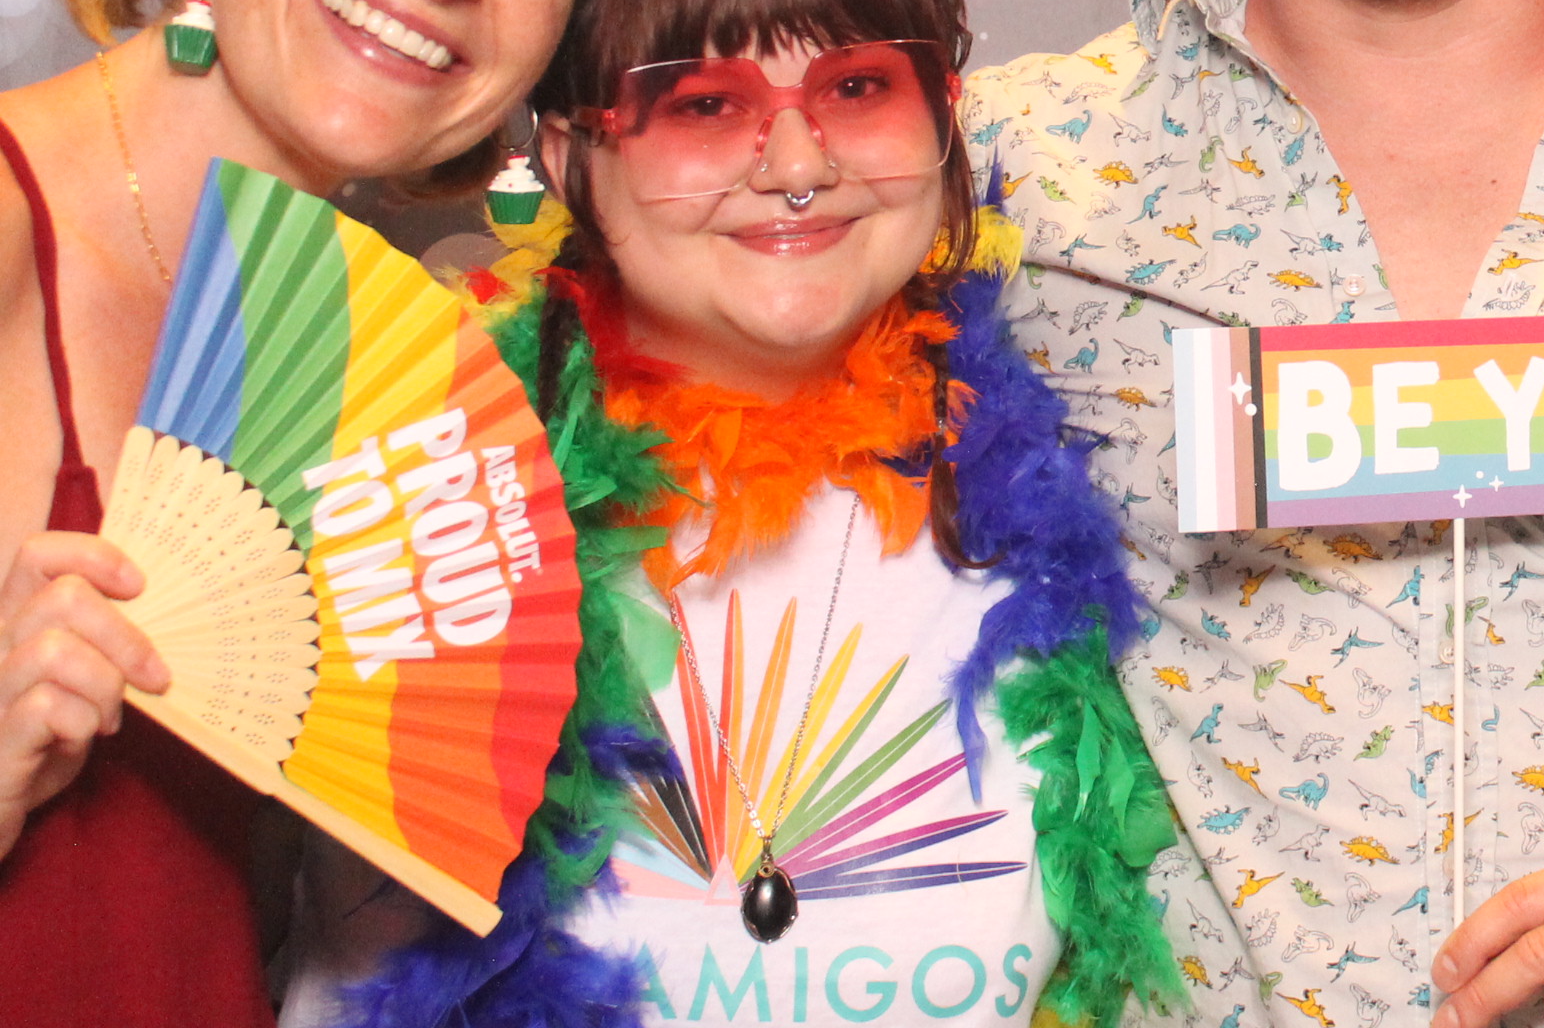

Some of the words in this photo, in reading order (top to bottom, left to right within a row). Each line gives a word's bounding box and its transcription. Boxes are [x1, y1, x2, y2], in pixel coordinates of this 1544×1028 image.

[302, 435, 395, 537] TO
[1276, 360, 1440, 492] BE
[386, 407, 513, 647] PROUD
[321, 538, 436, 683] MIX
[633, 942, 1032, 1024] AMIGOS
